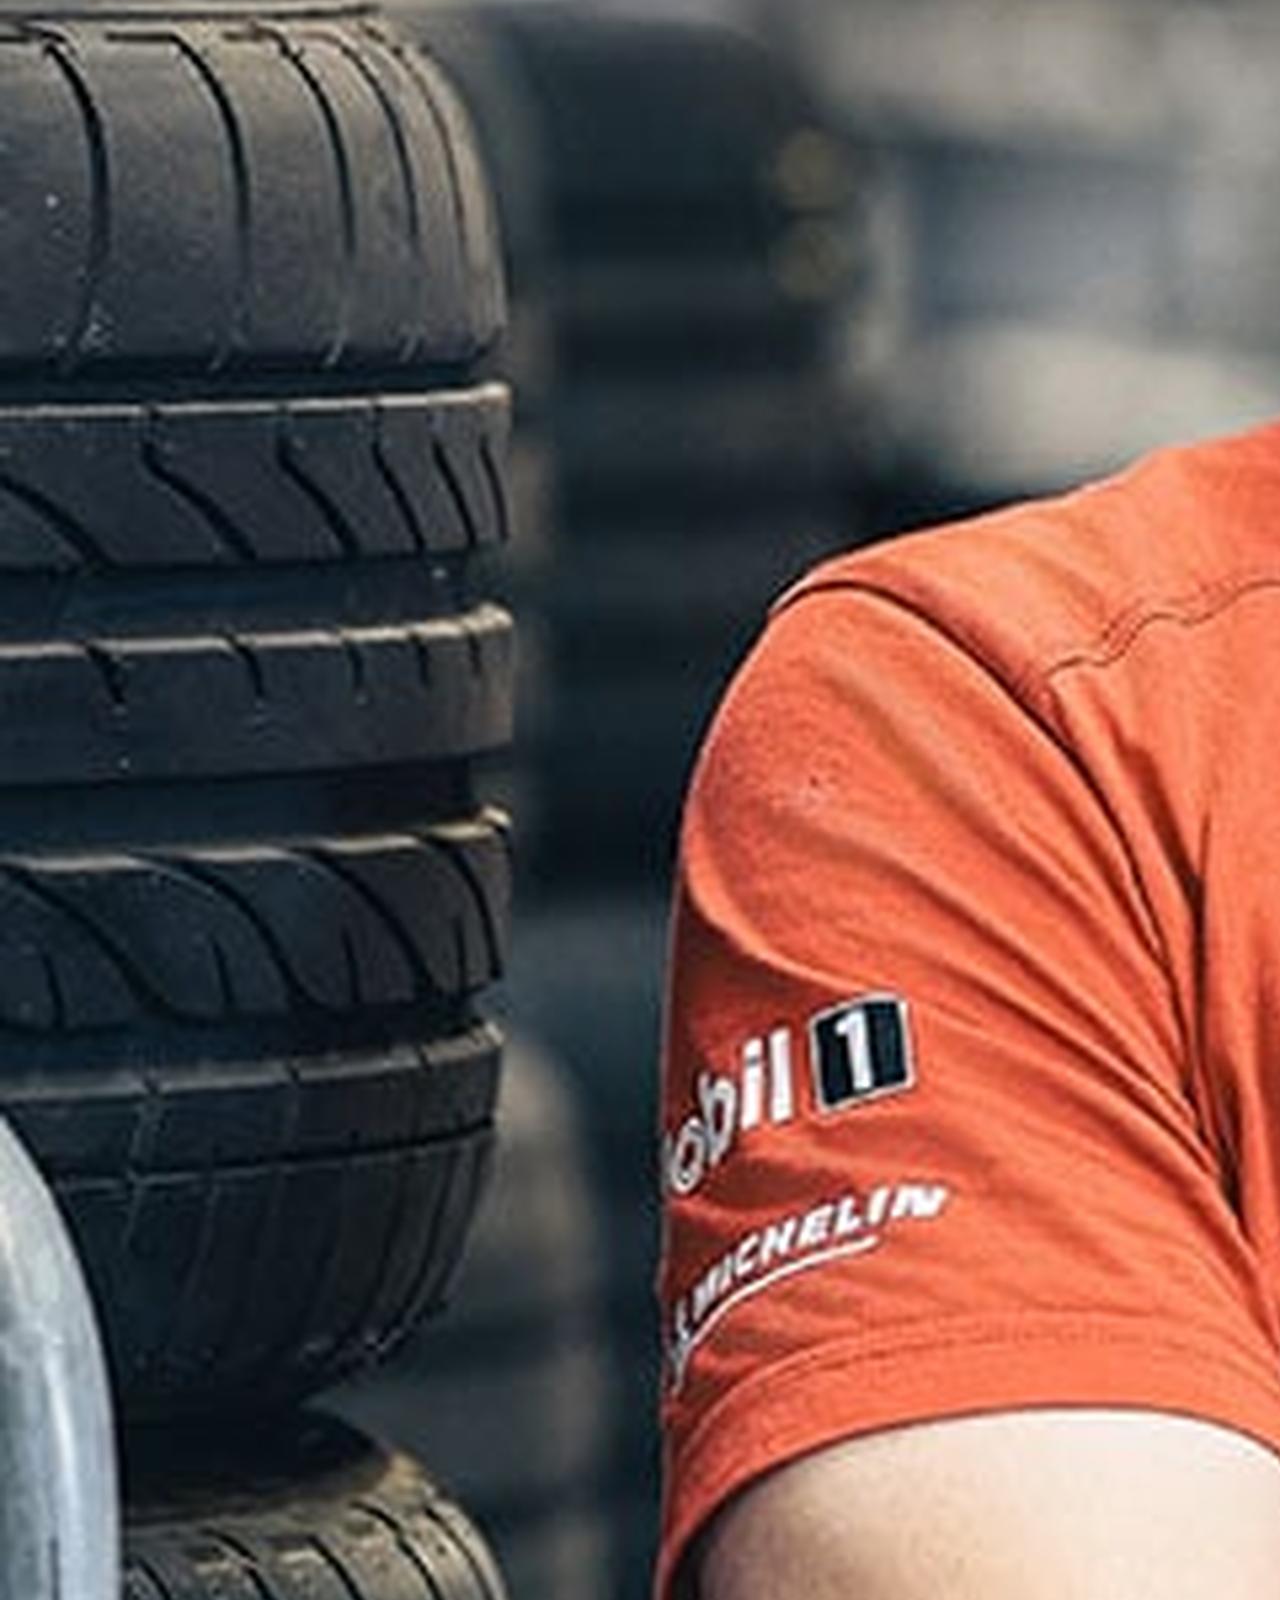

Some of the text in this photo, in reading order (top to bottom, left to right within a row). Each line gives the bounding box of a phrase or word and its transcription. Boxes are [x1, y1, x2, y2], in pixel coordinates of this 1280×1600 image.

[661, 1009, 875, 1193] obil 1
[692, 1185, 948, 1323] MICHELIN
